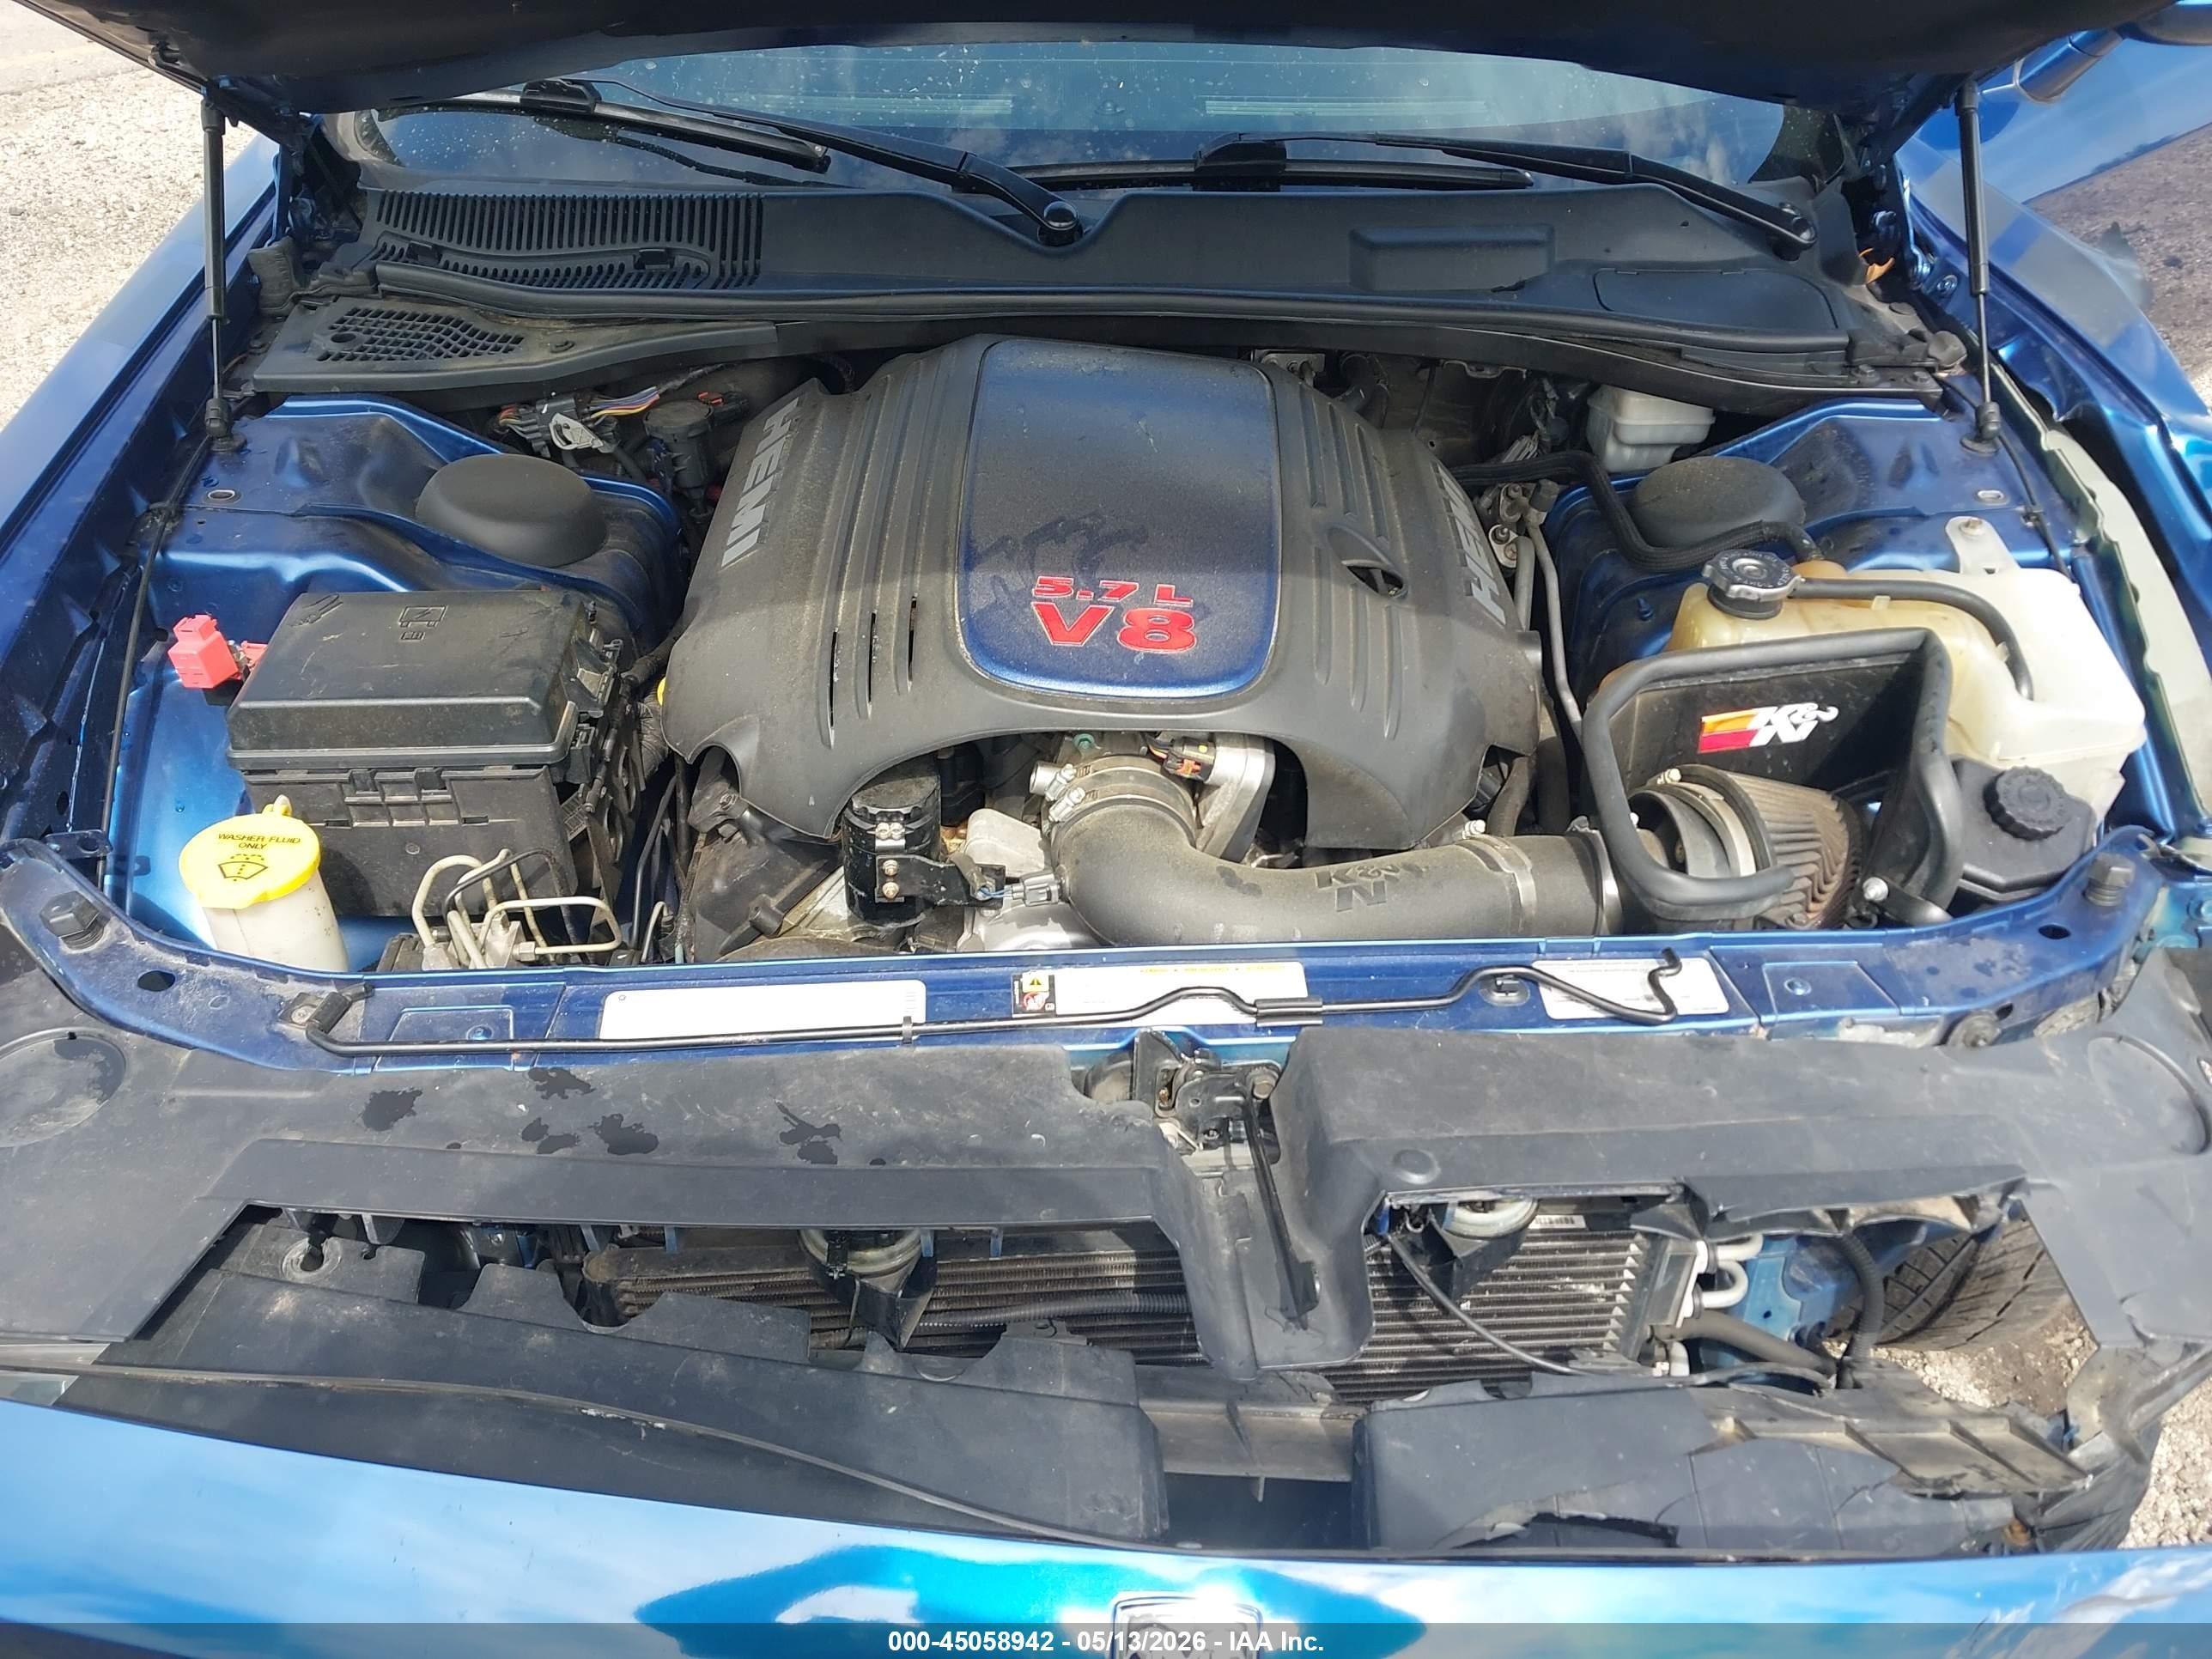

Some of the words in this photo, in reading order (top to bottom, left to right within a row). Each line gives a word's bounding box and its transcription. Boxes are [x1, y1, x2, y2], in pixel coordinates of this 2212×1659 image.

[720, 397, 799, 568] HEMI
[1032, 575, 1139, 602] 5.7
[1153, 583, 1193, 607] L
[1030, 601, 1197, 654] V8
[1747, 702, 1839, 748] K&N
[218, 833, 265, 842] WASHER
[268, 836, 301, 844] FLUID
[1315, 863, 1422, 912] K&N
